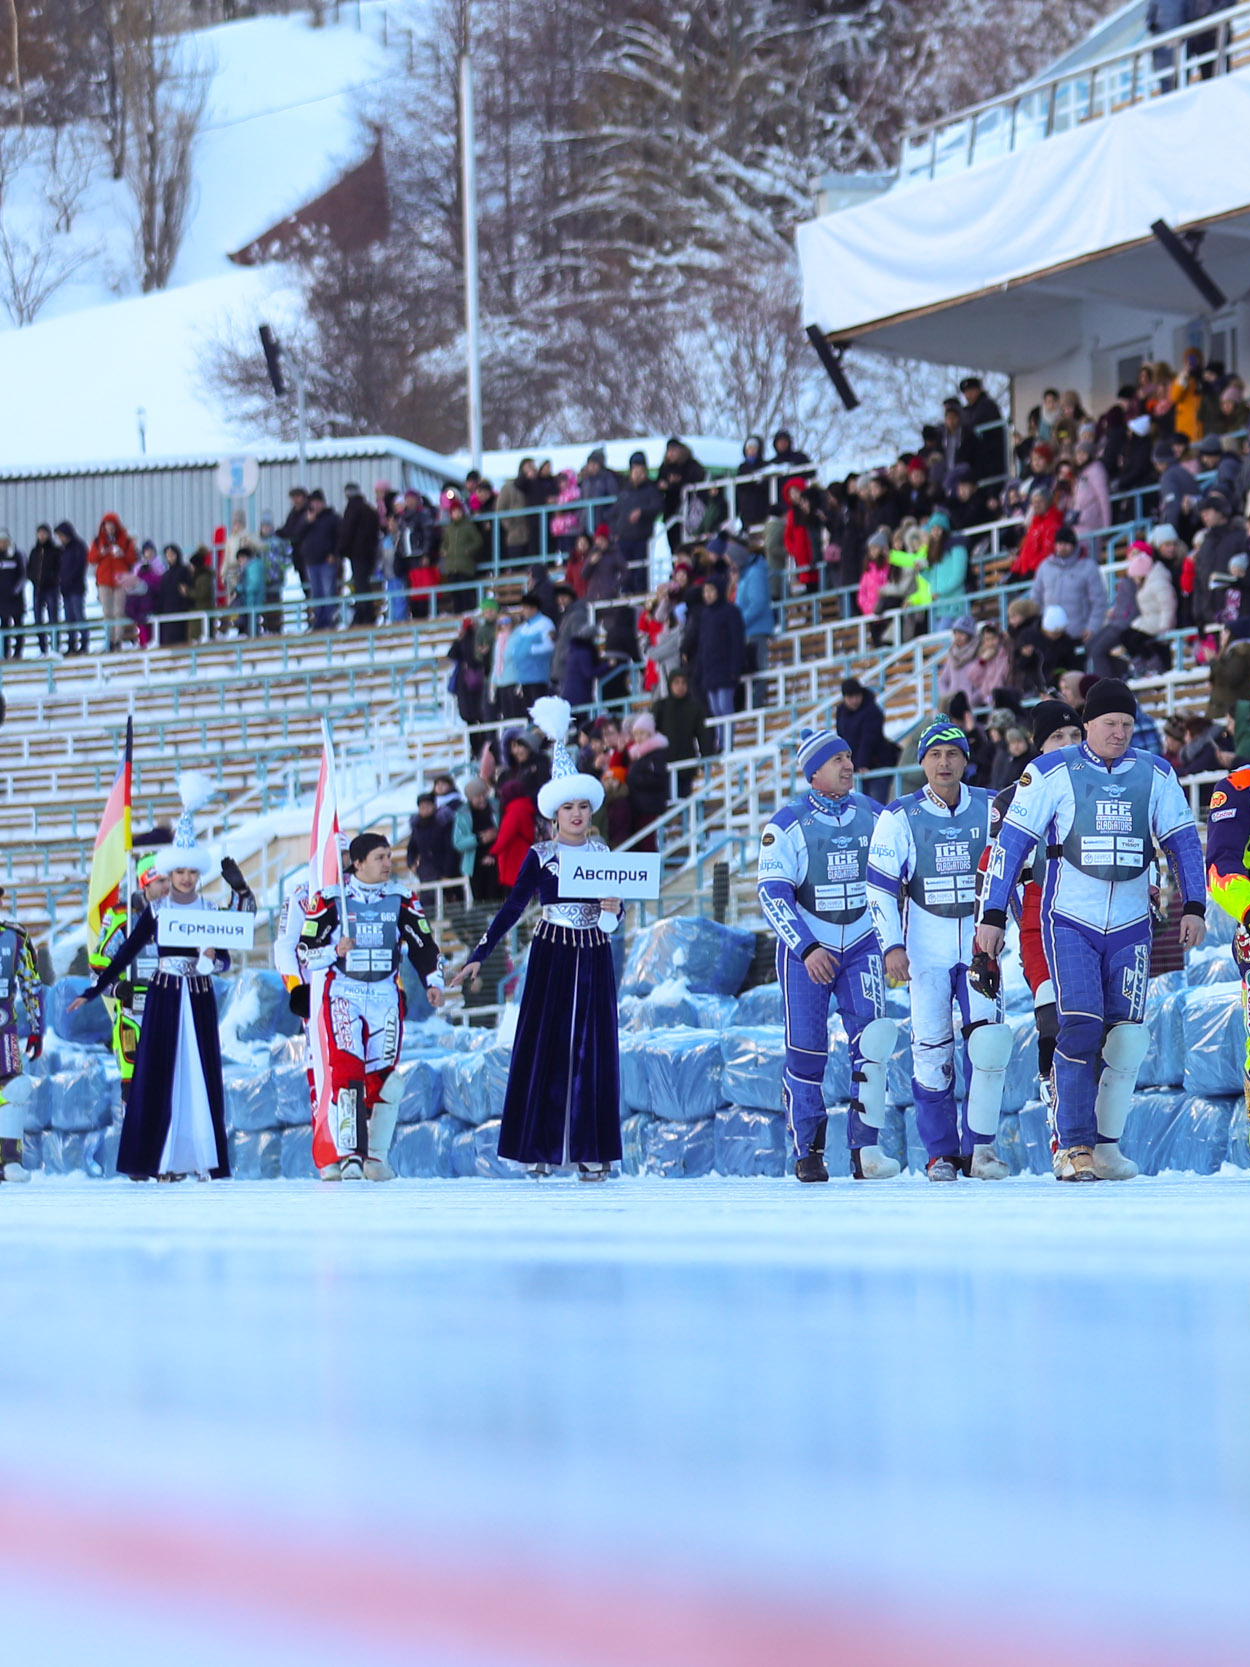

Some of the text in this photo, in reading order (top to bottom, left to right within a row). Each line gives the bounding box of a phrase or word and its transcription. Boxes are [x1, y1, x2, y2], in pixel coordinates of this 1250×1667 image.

[1096, 802, 1132, 816] ICE
[970, 827, 980, 839] 17
[858, 836, 868, 847] 18
[935, 844, 969, 857] ICE
[827, 853, 859, 866] ICE
[573, 865, 648, 884] Австрия
[169, 920, 244, 935] Германия
